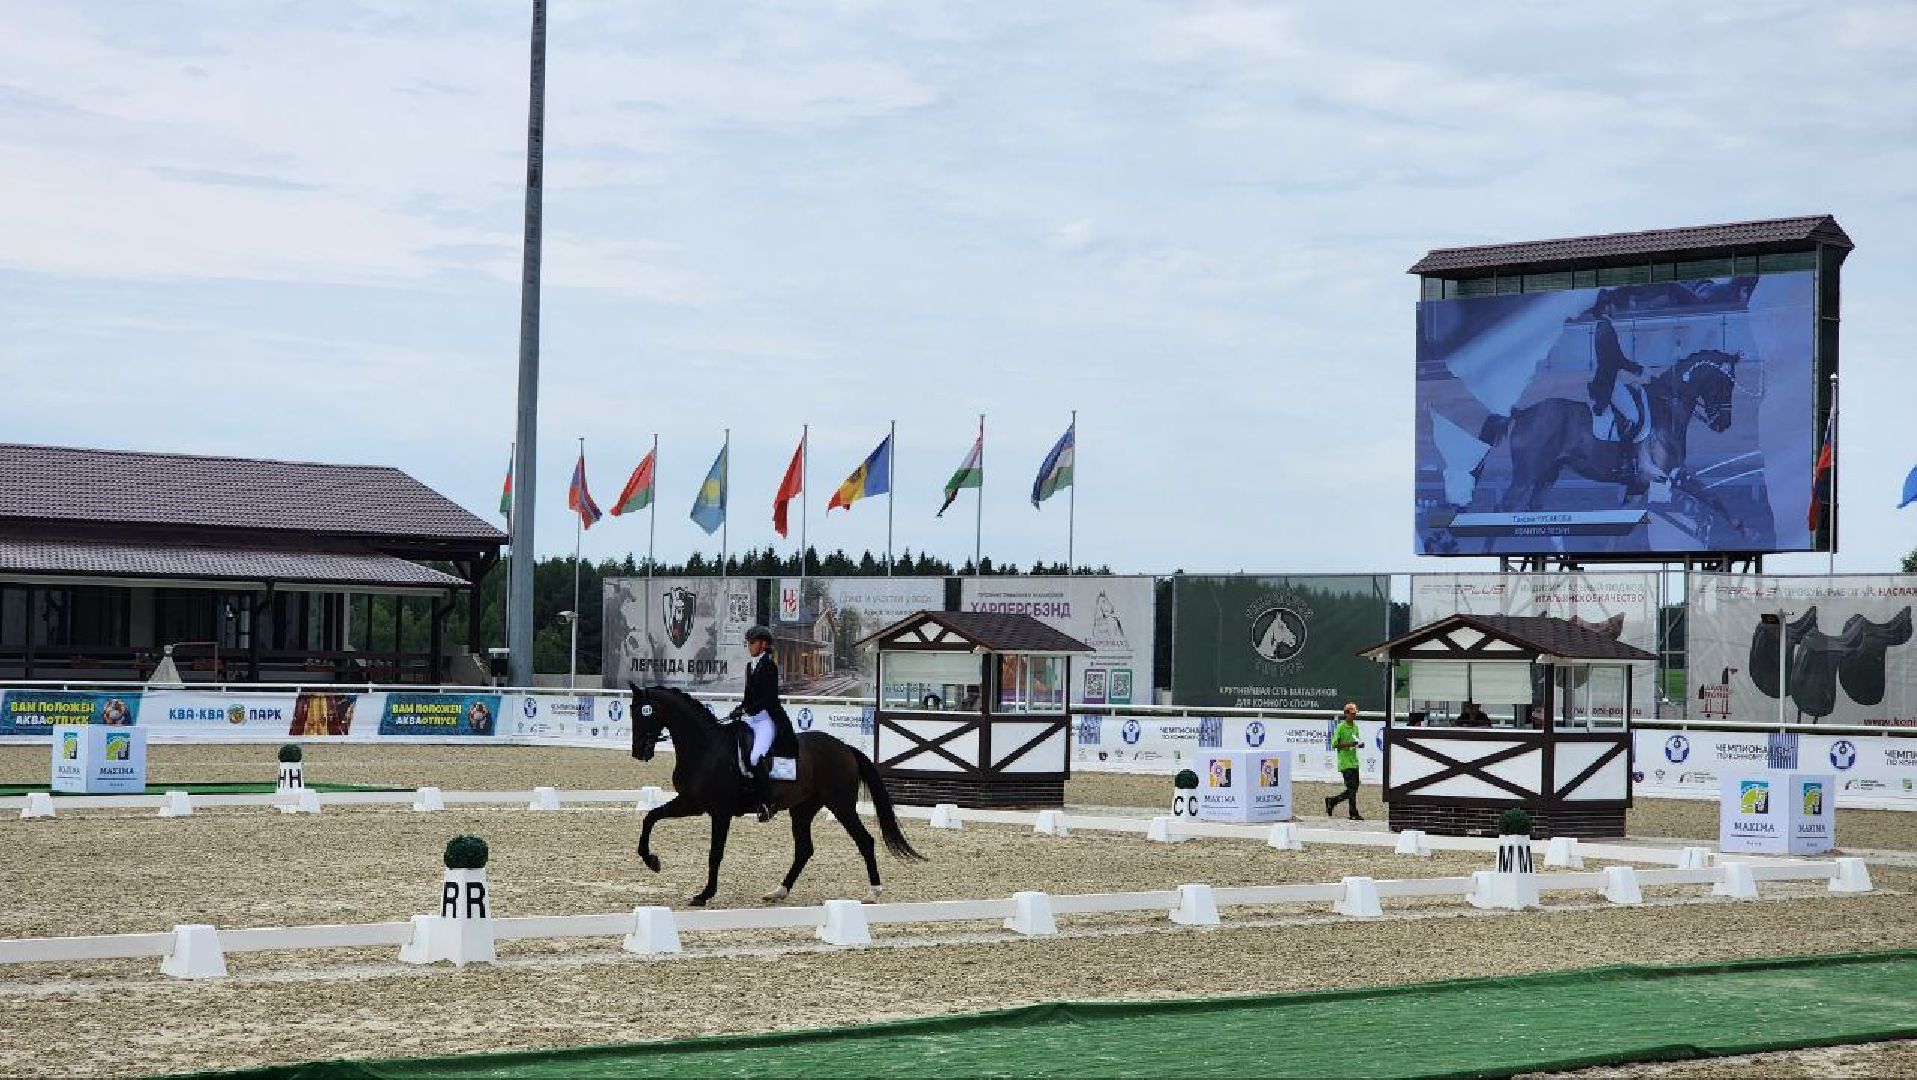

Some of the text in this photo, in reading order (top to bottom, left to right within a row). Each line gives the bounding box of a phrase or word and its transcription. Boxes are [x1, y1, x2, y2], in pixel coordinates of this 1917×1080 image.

[1599, 593, 1645, 603] КАЧЕСТВО
[971, 602, 1071, 618] ХАРПЕРСБЭНД
[630, 659, 728, 675] ЛЕГЕНДА ВОЛГИ
[1273, 687, 1288, 696] СЕТЬ
[11, 701, 95, 712] ВАМ ПОЛОЖЕН
[1235, 698, 1249, 708] ДЛЯ
[1251, 699, 1288, 708] КОННОГО
[392, 703, 462, 714] ВАМ ПОЛОЖЕН
[249, 709, 282, 720] ПАРК
[100, 767, 135, 775] MAXIMA
[1734, 822, 1775, 832] MAXIMA
